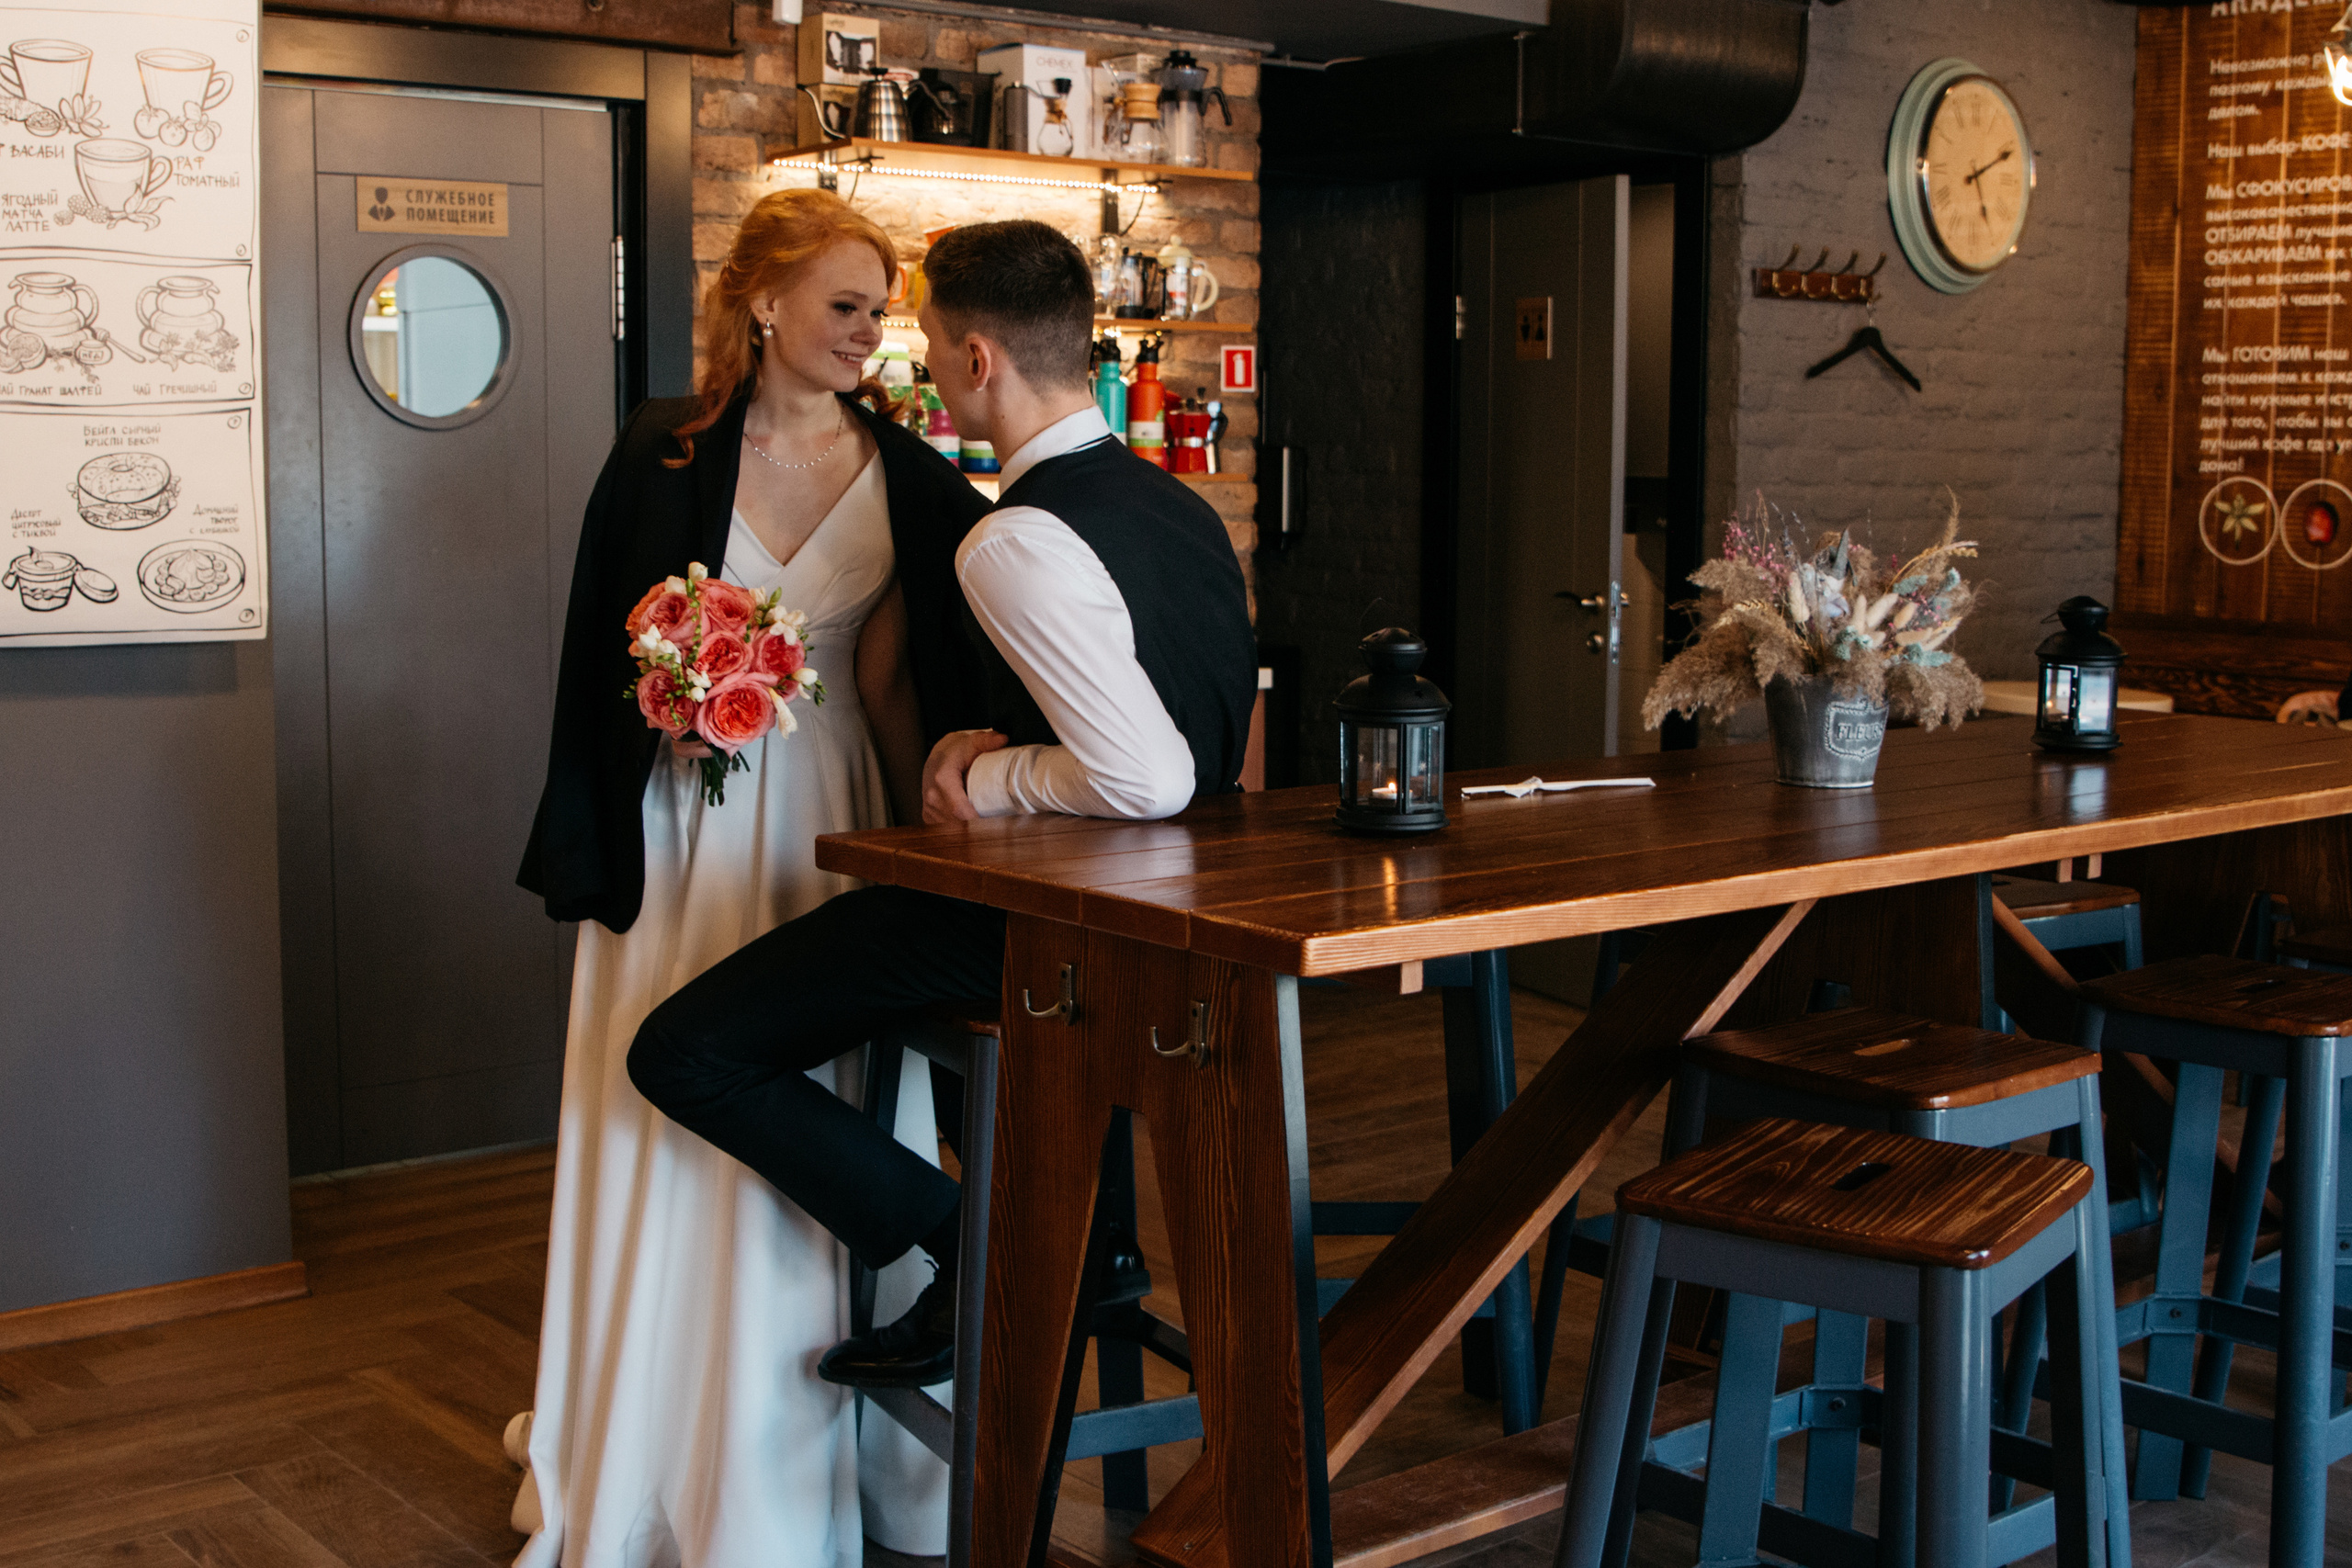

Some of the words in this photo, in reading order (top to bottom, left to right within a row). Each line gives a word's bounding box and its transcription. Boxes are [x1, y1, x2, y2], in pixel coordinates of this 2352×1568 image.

[10, 144, 64, 159] ВАСАБИ
[2207, 142, 2245, 159] Наш
[174, 155, 205, 171] РАФ
[174, 172, 240, 187] ТОМАТНЫЙ
[1, 188, 58, 208] ЯГОДНЫЙ
[405, 189, 495, 207] СЛУЖЕБНОЕ
[2206, 183, 2234, 200] Мы
[2, 208, 43, 220] МАТЧА
[405, 208, 495, 225] ПОМЕЩЕНИЕ
[6, 220, 50, 232] ЛАТТЕ
[2205, 223, 2293, 244] ОТБИРАЕМ
[2205, 243, 2323, 266] ОБЖАРИВАЕМ
[2202, 346, 2229, 363] Мы
[2233, 344, 2312, 363] ГОТОВИМ
[0, 382, 14, 396] АЙ
[19, 386, 52, 396] ГРАНАТ
[60, 384, 102, 396] ШАЛФЕЙ
[133, 383, 151, 395] ЧАЙ
[84, 424, 116, 436] БЕЙГЛ
[128, 436, 160, 446] БЕКОН
[2262, 434, 2304, 455] кофе
